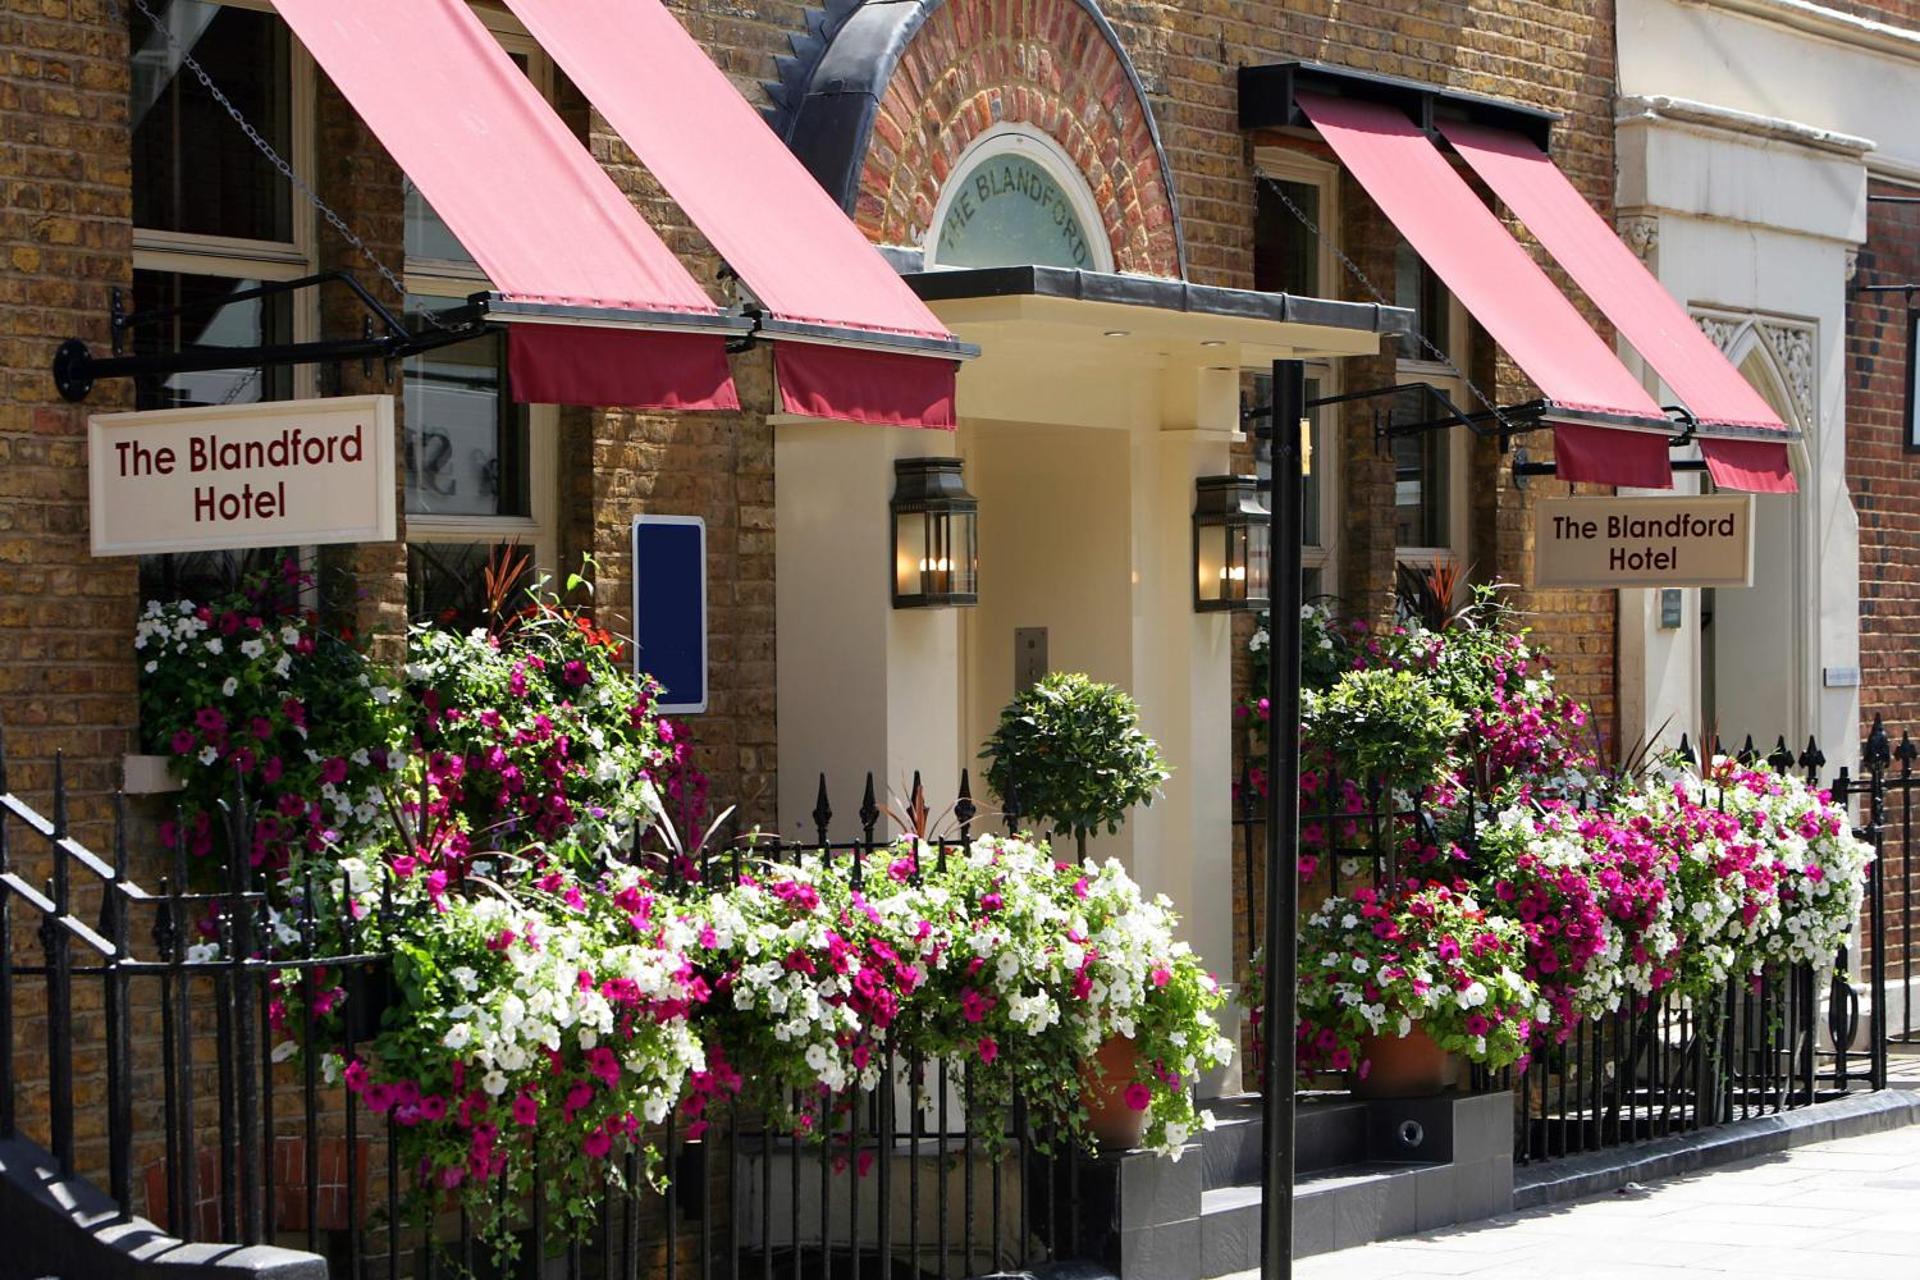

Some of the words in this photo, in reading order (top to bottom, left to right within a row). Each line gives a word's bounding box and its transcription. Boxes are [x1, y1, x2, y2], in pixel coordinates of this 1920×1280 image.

[939, 191, 976, 249] THE
[975, 166, 1086, 265] BLANDFORD
[115, 440, 176, 477] The
[189, 424, 363, 472] Blandford
[194, 481, 286, 522] Hotel
[1553, 516, 1598, 539] The
[1607, 513, 1735, 538] Blandford
[1609, 546, 1677, 570] Hotel
